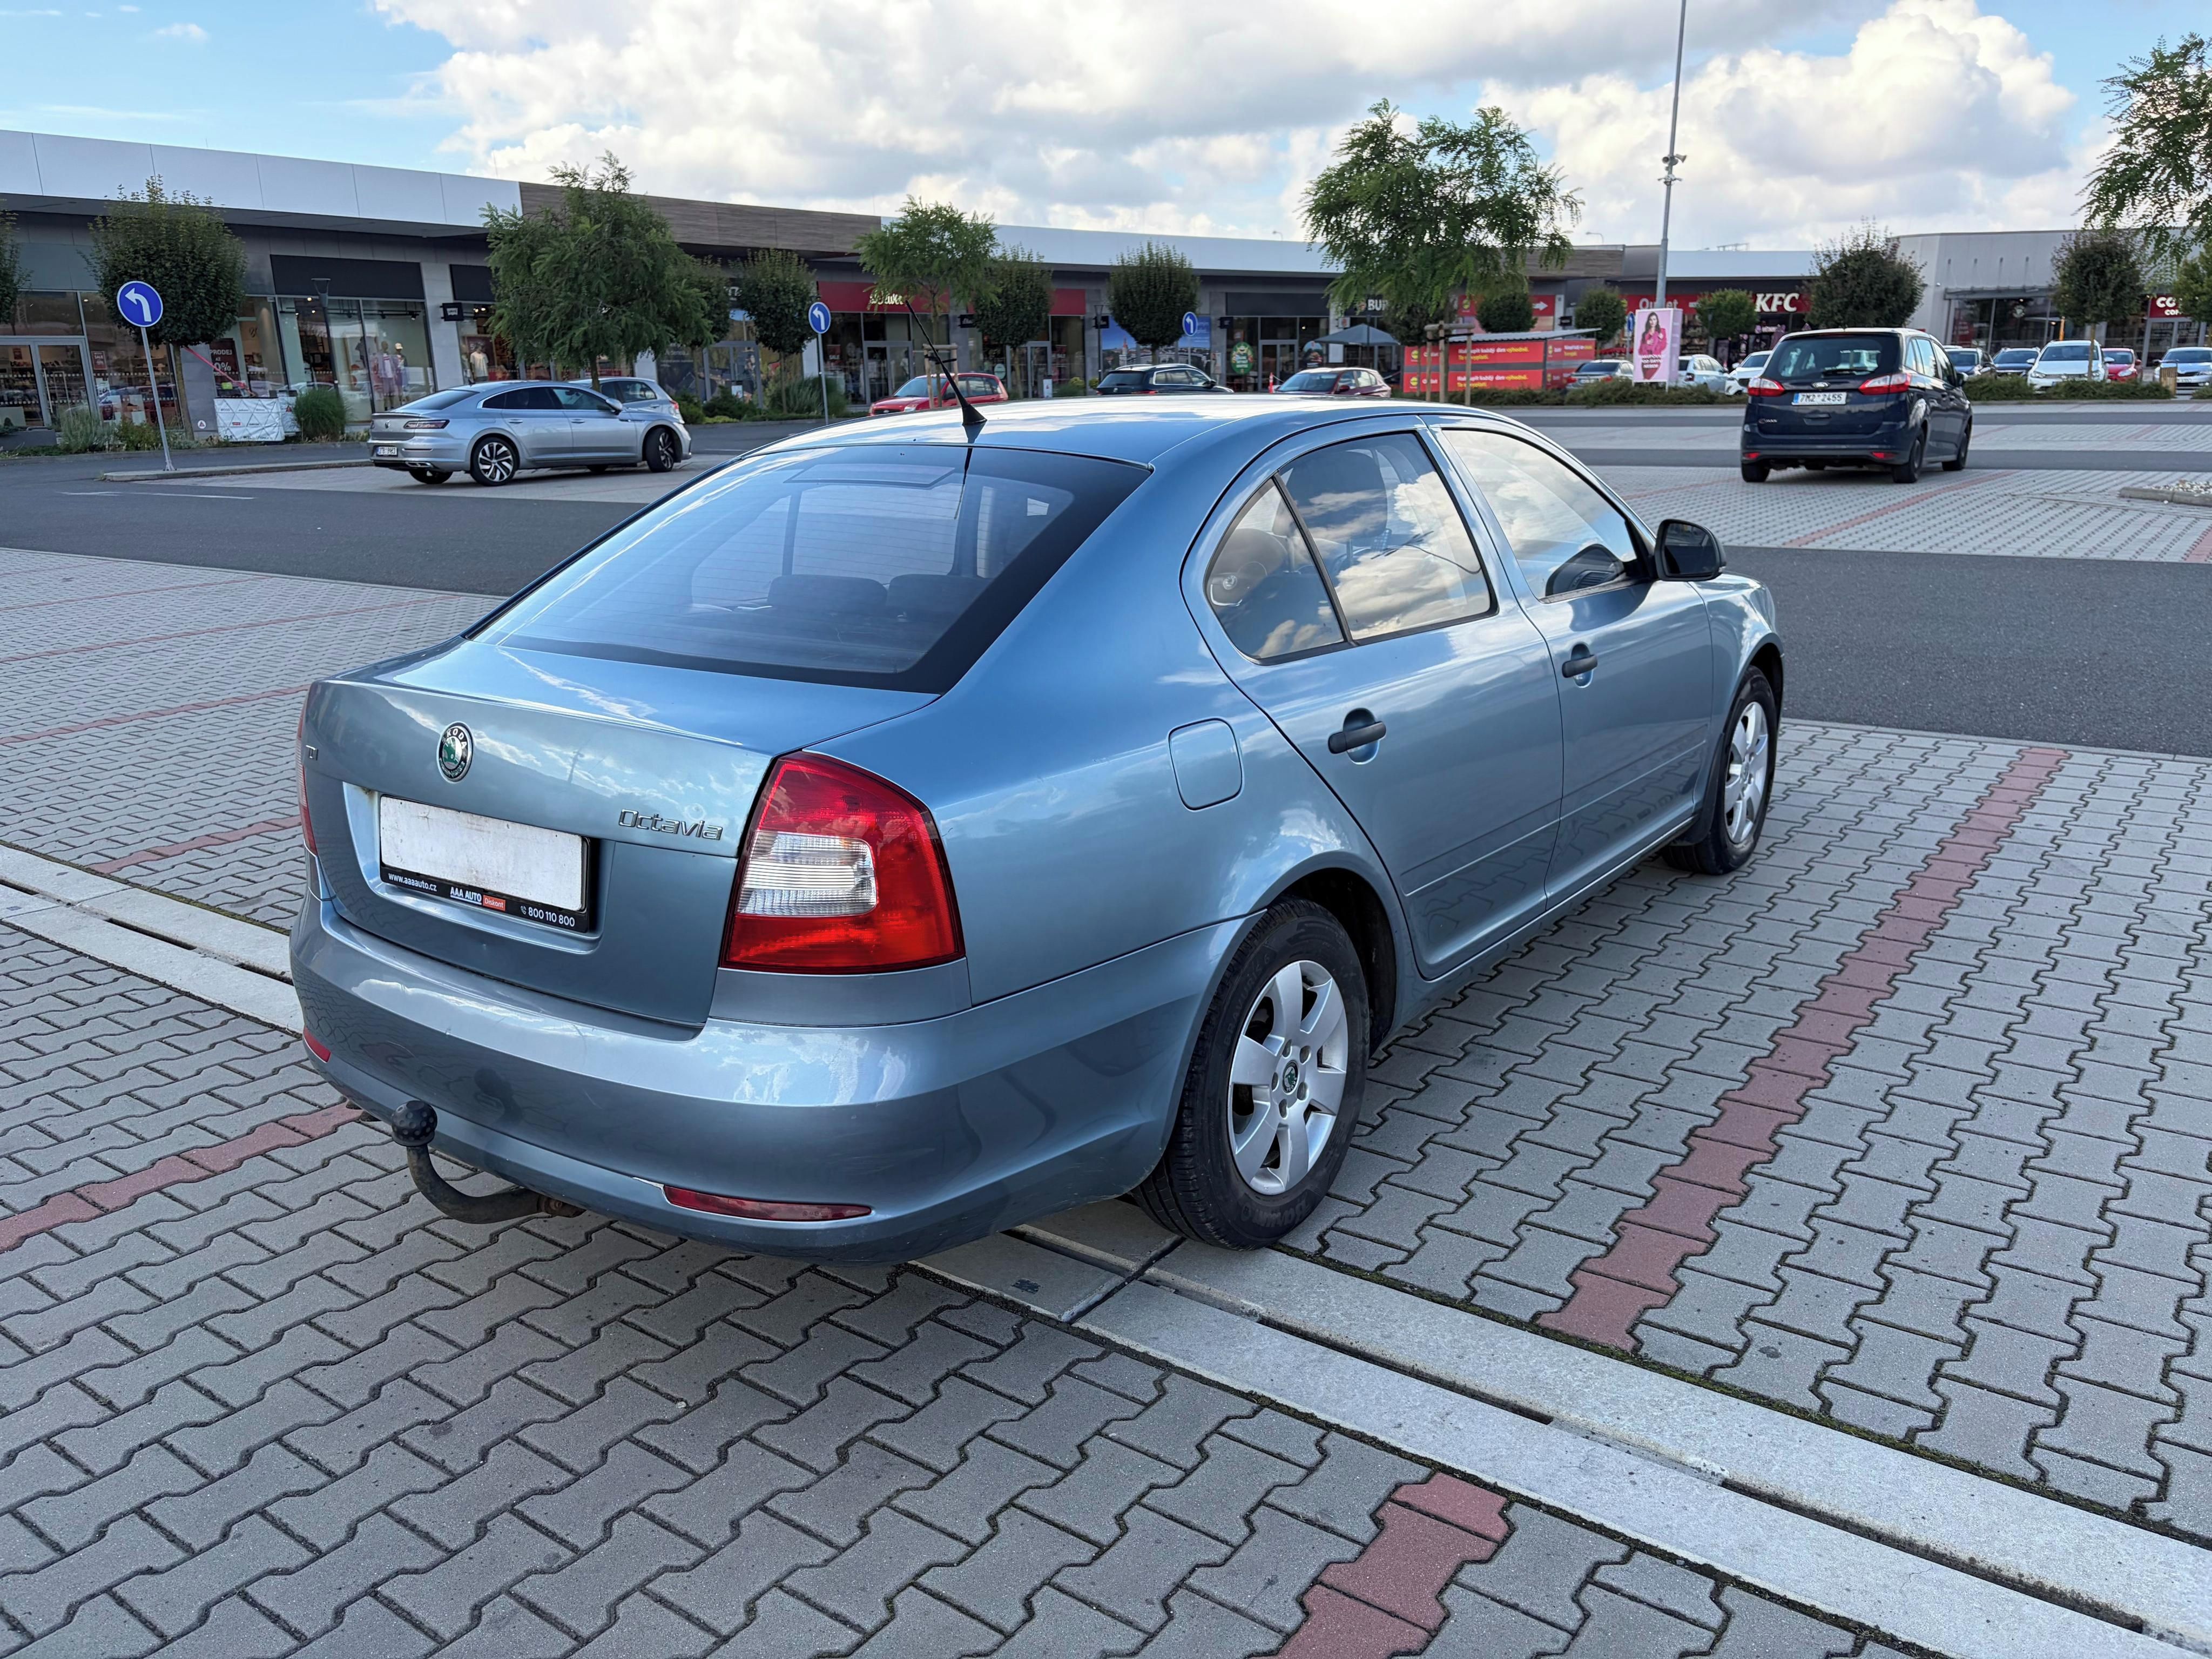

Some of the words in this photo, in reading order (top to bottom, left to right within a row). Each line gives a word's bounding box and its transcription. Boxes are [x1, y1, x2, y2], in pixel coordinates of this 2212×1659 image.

[1754, 293, 1799, 312] KFC
[618, 808, 723, 840] Octavia
[388, 873, 437, 892] www.aaaauto.cz
[450, 886, 463, 898] AAA
[465, 890, 482, 902] AUTO
[484, 898, 504, 908] Diskont
[528, 907, 544, 920] 800
[545, 911, 557, 922] 110
[559, 914, 575, 927] 800
